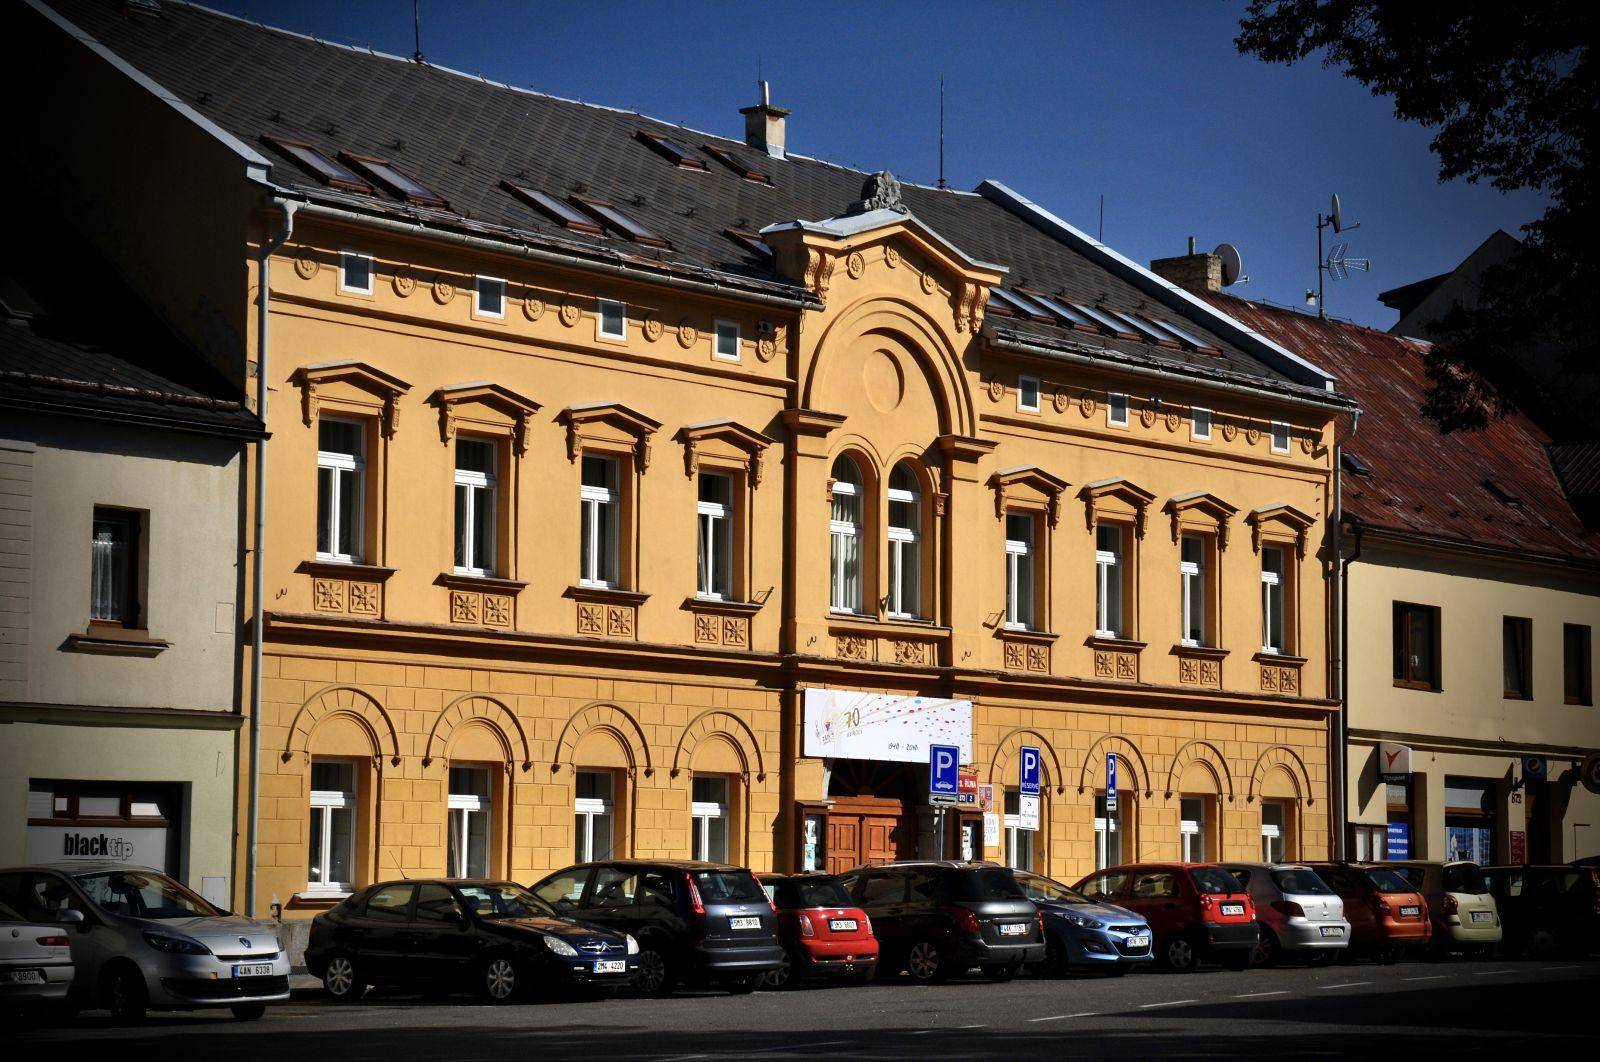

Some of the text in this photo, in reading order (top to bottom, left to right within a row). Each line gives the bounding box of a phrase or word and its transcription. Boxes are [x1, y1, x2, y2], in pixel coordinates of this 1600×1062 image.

[844, 707, 860, 729] 70
[936, 751, 953, 778] P
[1024, 752, 1036, 779] P
[1108, 758, 1115, 784] P
[64, 833, 133, 861] black tip
[239, 965, 271, 976] 4AN 6338
[611, 961, 624, 970] 4220
